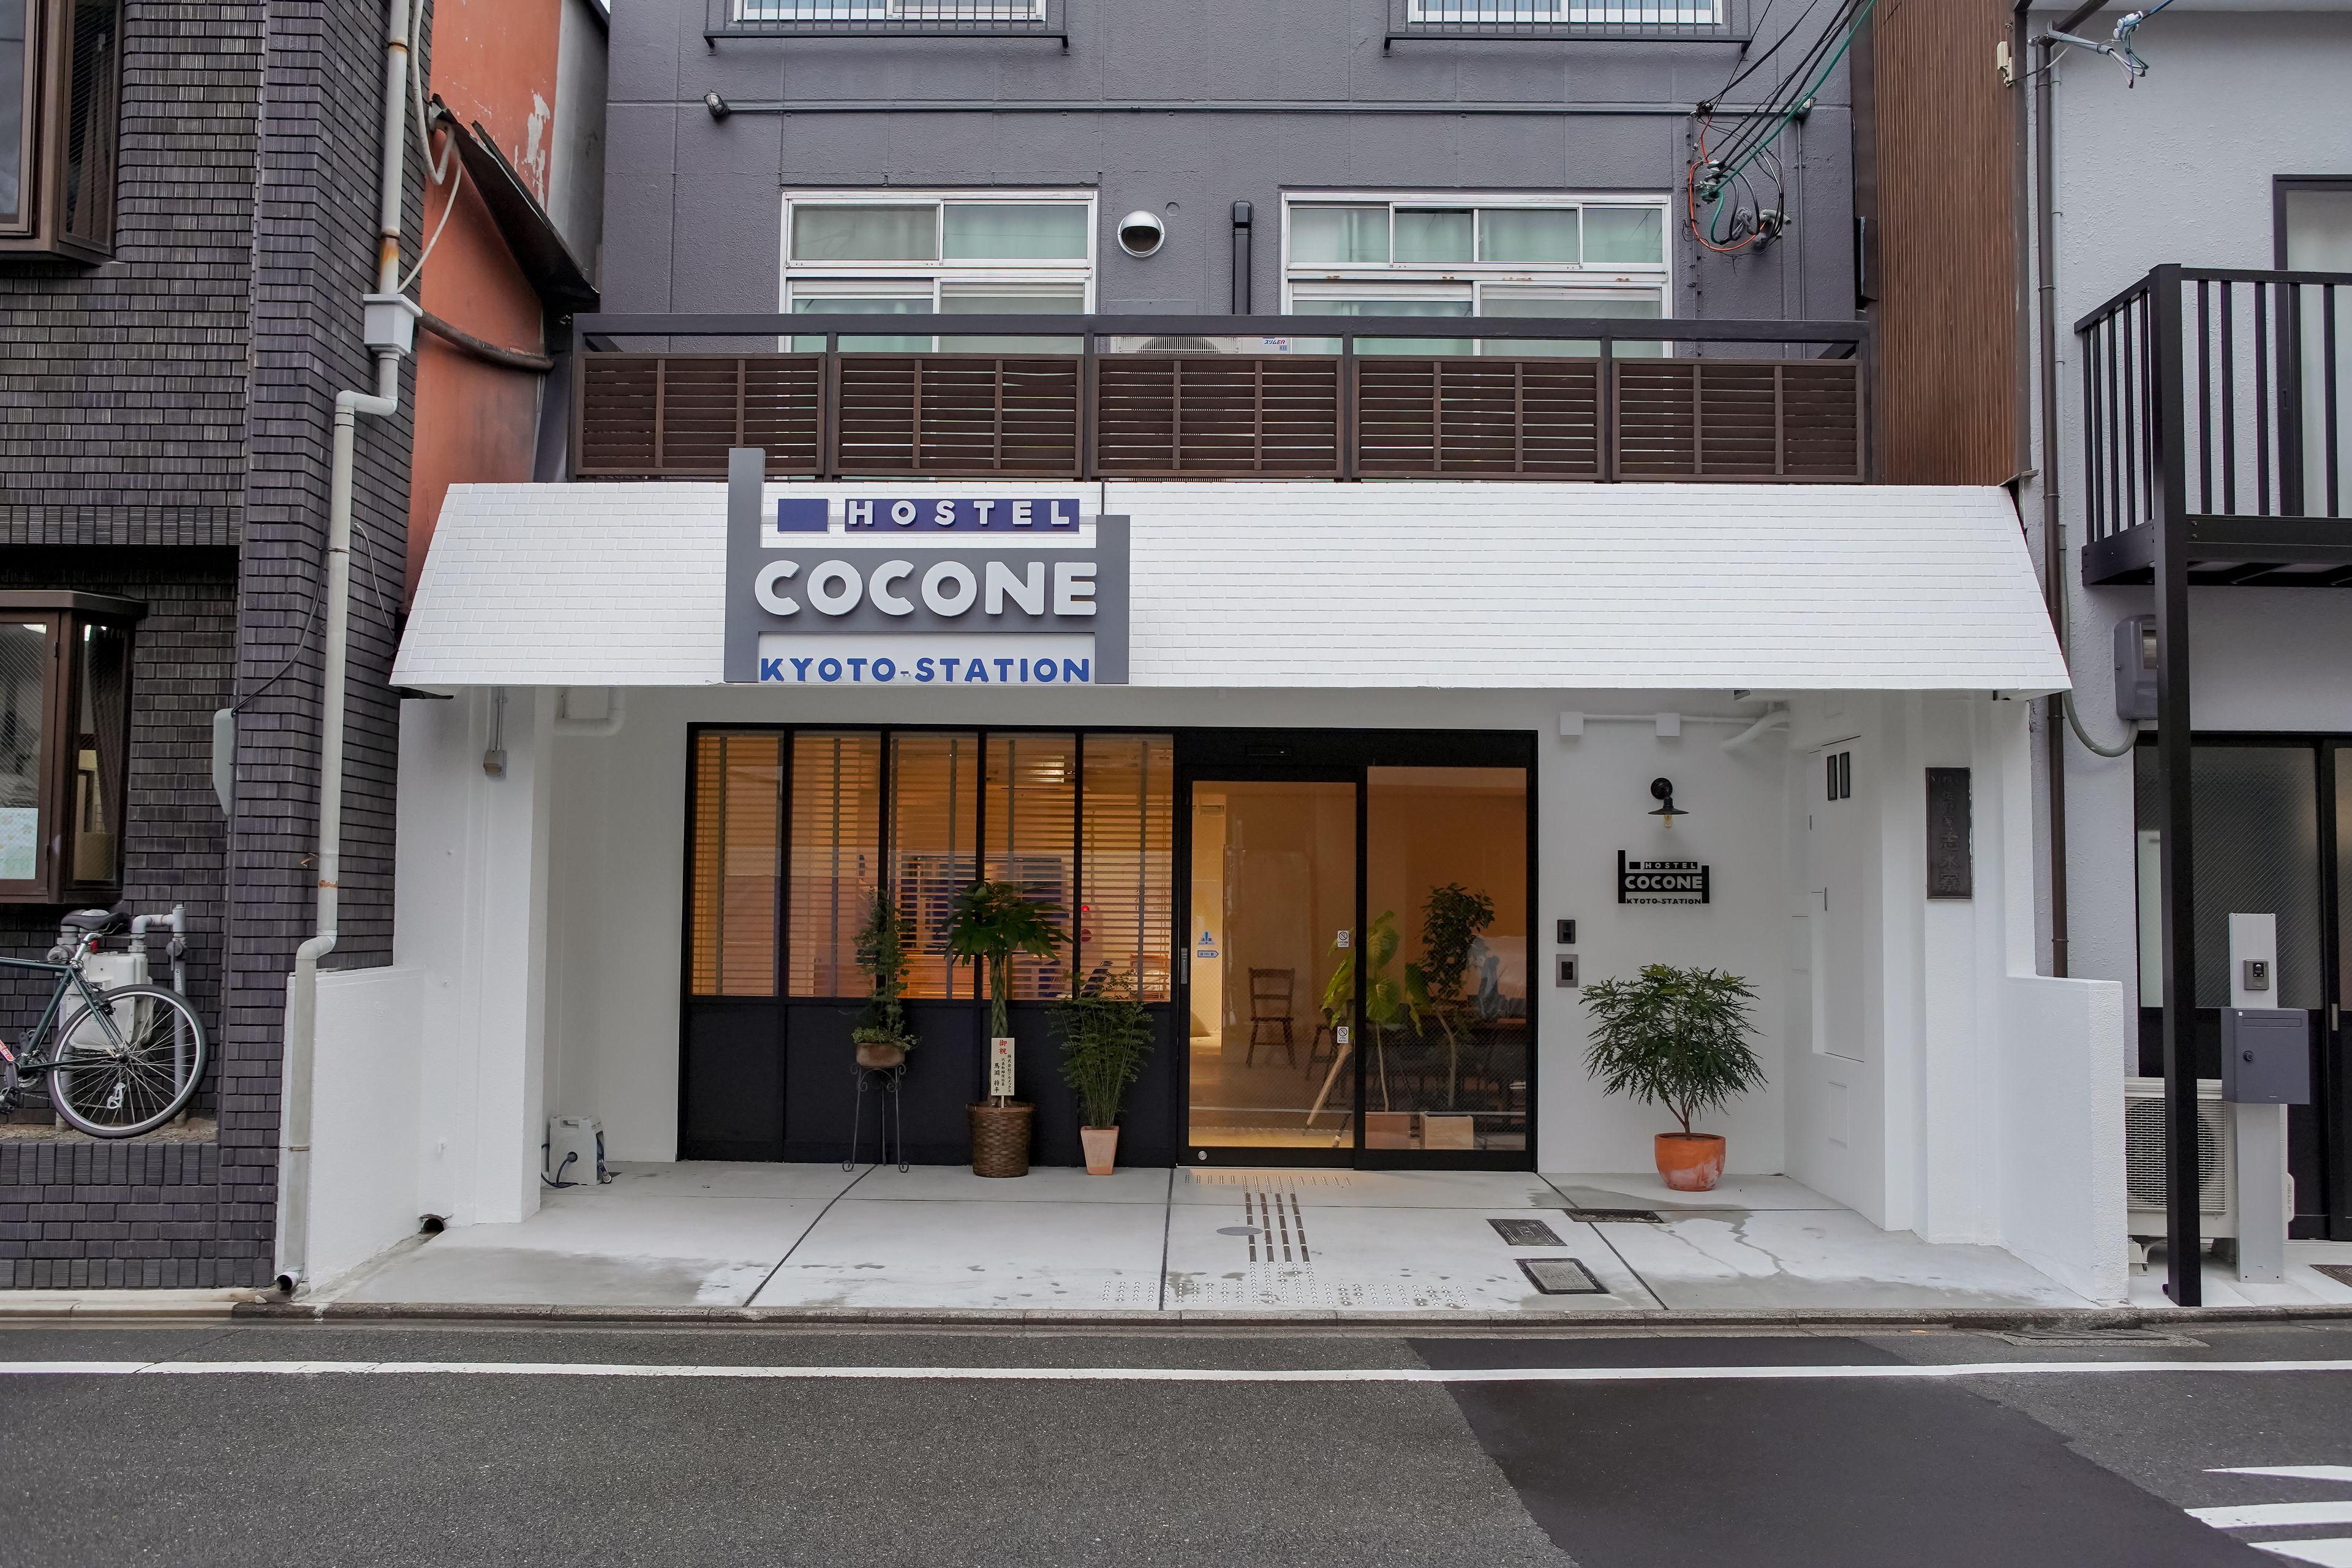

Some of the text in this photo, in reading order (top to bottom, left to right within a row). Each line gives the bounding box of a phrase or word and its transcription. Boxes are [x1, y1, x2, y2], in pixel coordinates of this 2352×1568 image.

[848, 500, 1071, 526] HOSTEL
[754, 559, 1098, 617] COCONE
[760, 657, 1090, 682] KYOTO-STATION
[1624, 875, 1703, 889] COCONE
[999, 1039, 1007, 1054] 御祝
